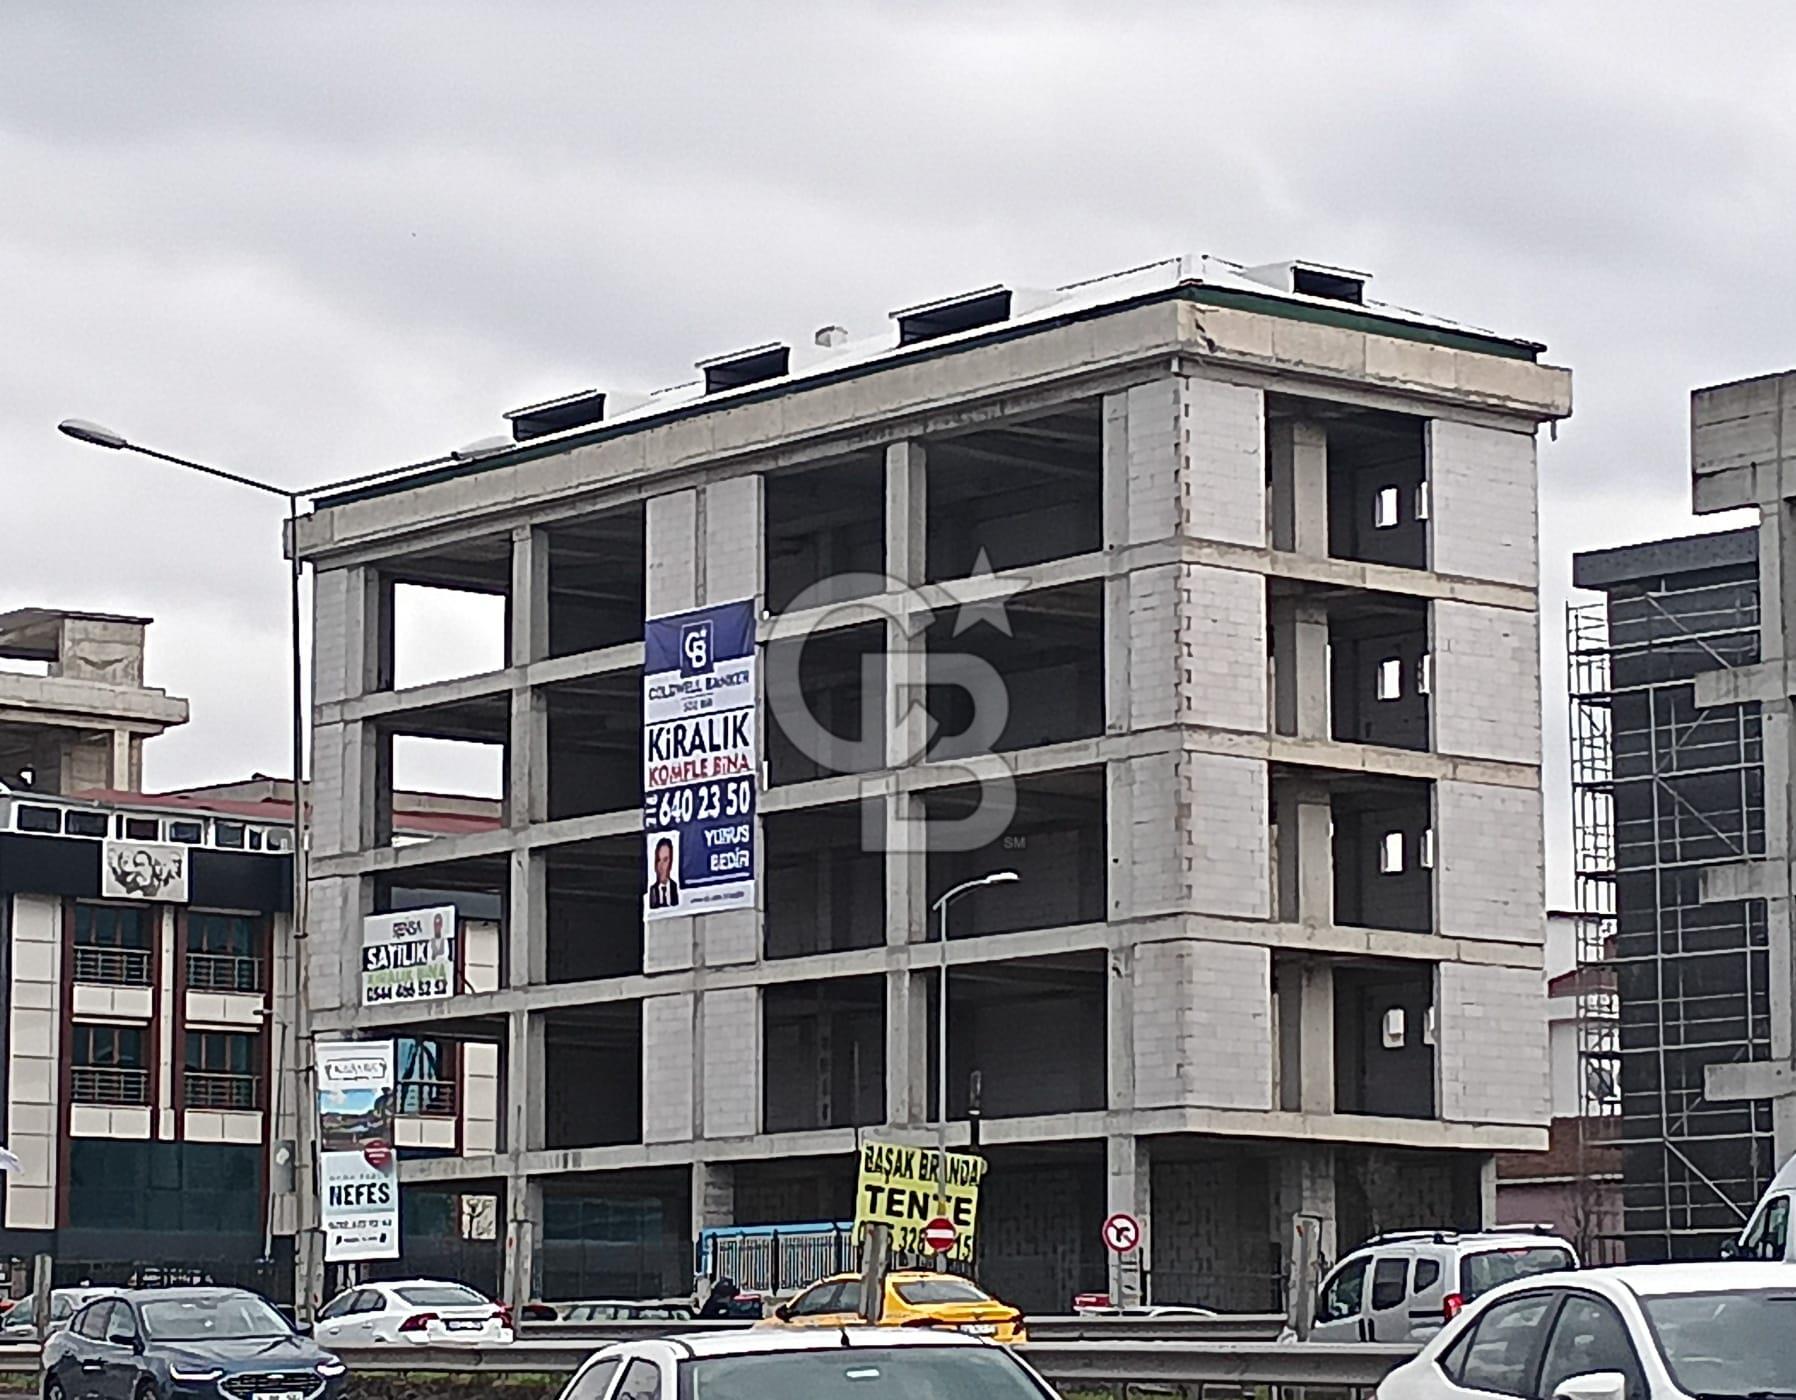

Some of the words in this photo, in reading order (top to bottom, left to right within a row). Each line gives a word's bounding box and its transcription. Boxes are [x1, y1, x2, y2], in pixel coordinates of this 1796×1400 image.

[660, 789, 693, 826] 640
[697, 785, 720, 819] 23
[726, 781, 750, 815] 50
[864, 1145, 915, 1184] BAŞAK
[329, 1183, 390, 1207] NEFES
